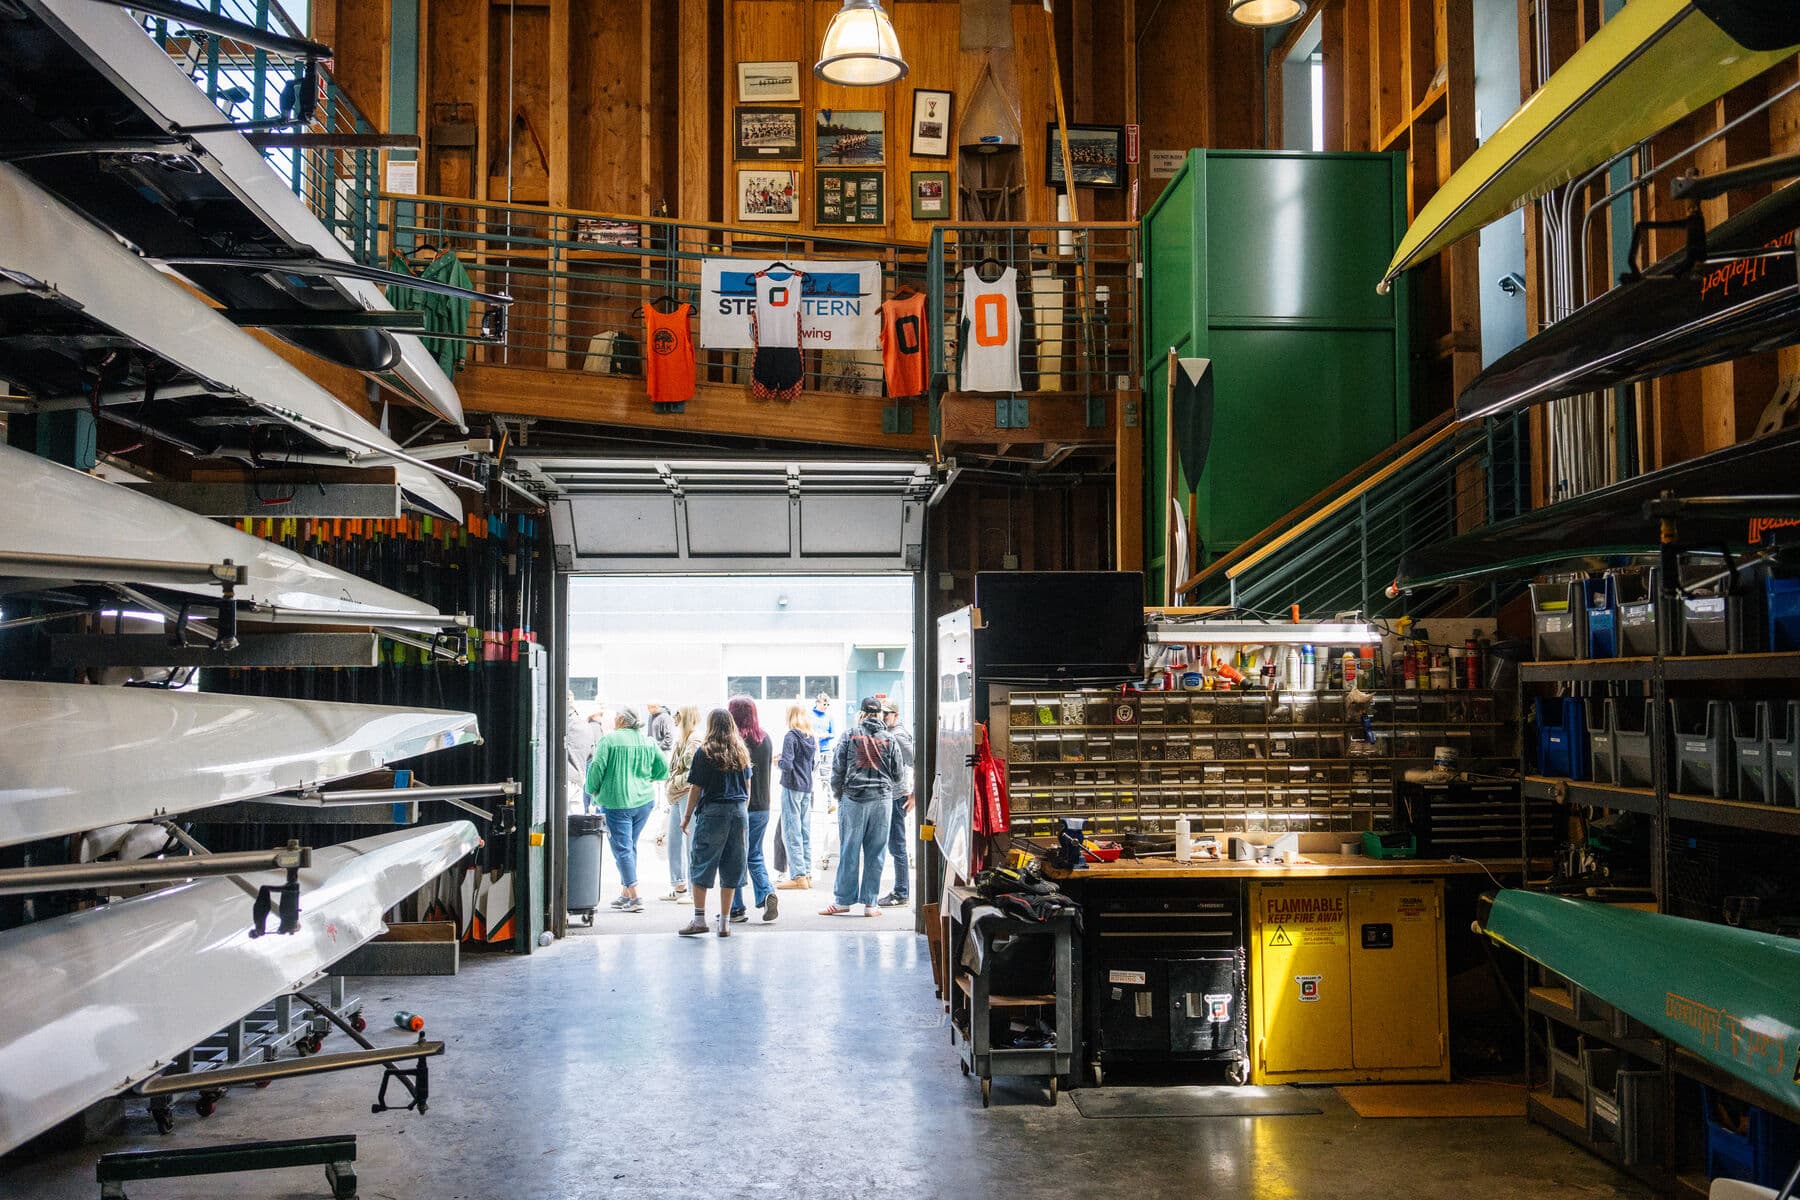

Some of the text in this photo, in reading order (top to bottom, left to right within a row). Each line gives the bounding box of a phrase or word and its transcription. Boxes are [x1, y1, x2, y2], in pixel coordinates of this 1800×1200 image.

[719, 298, 860, 316] STE TERN
[1267, 897, 1344, 913] FLAMMABLE
[1267, 911, 1344, 924] KEEP FIRE AWAY
